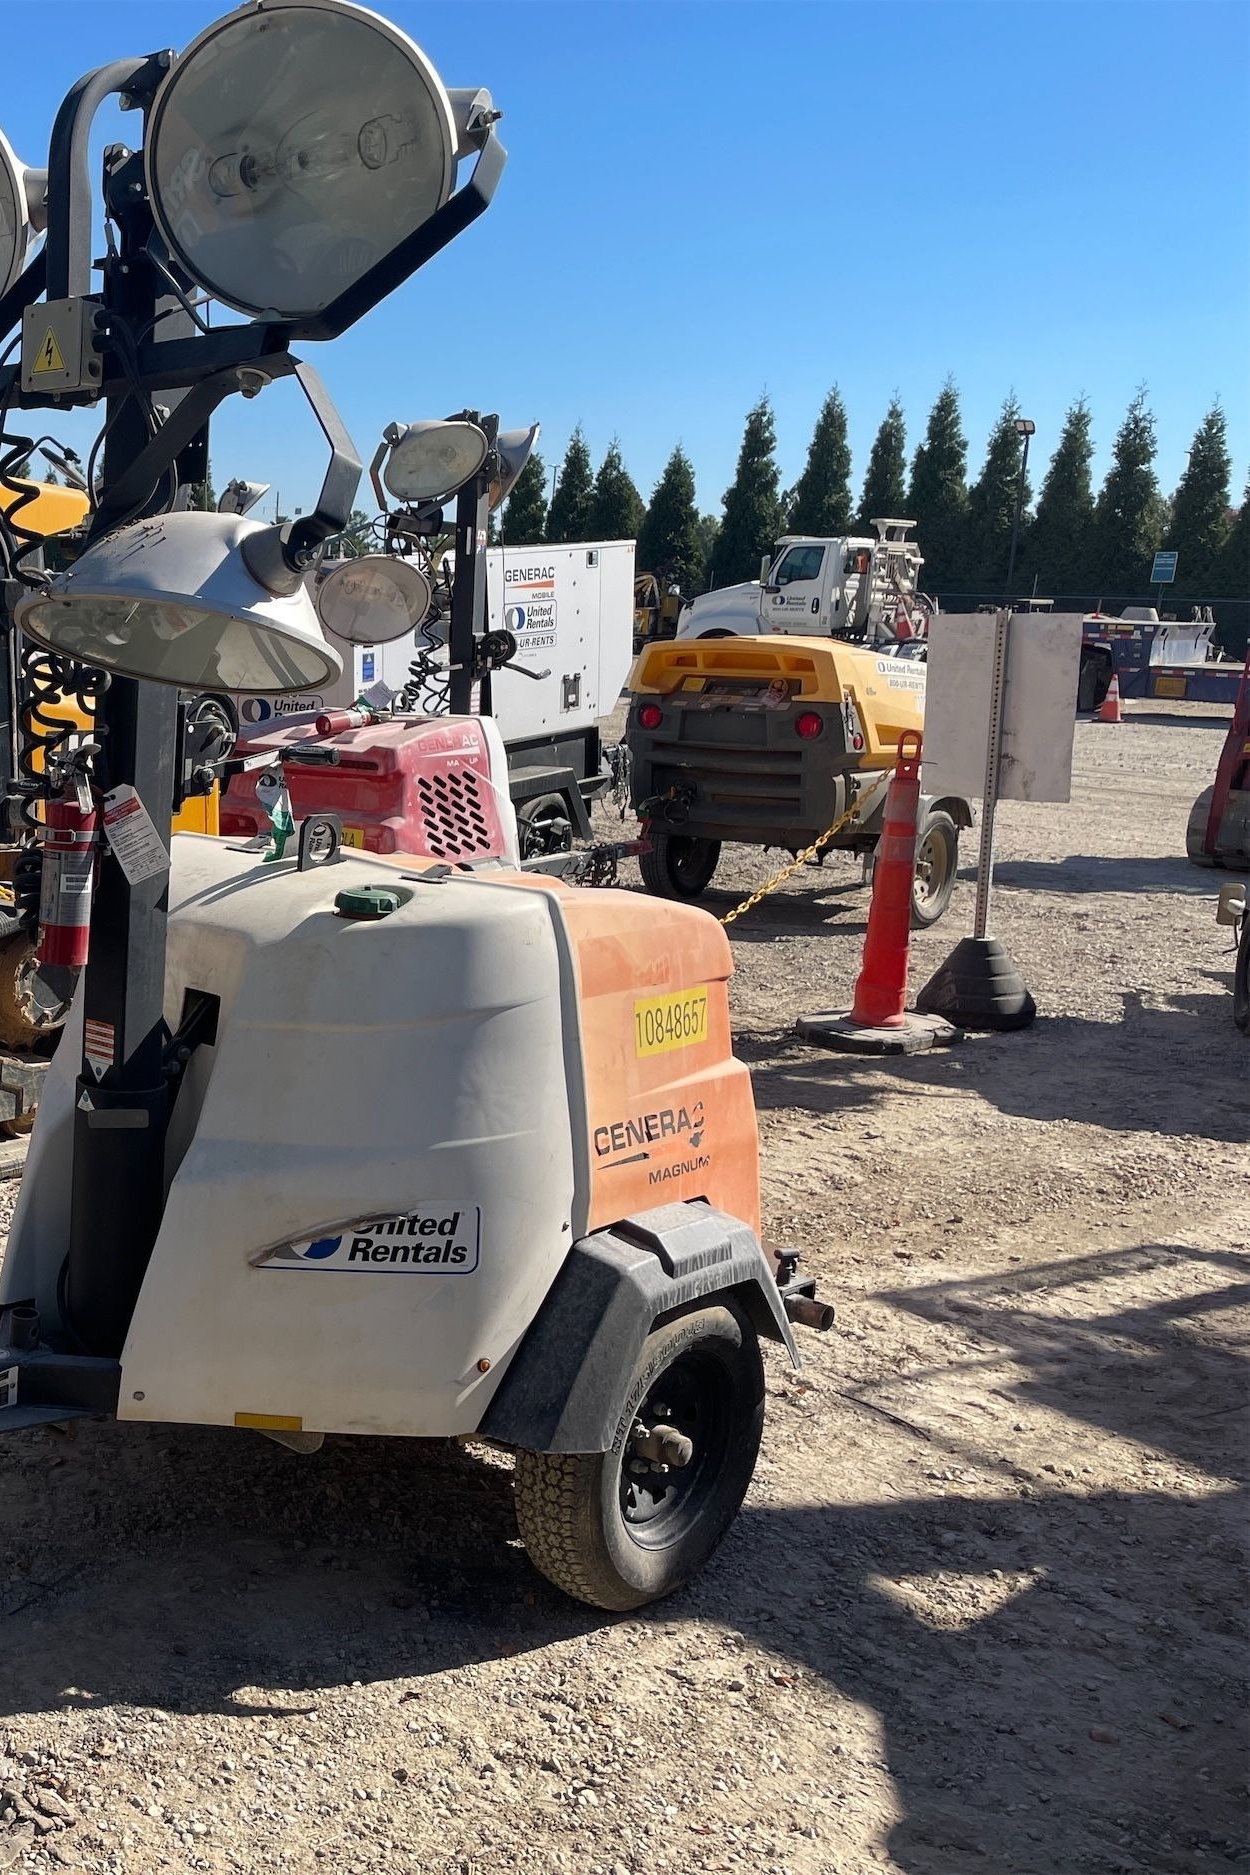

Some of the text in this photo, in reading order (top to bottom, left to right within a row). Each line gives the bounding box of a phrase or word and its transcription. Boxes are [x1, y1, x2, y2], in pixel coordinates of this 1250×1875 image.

[505, 566, 555, 582] GENERAC
[532, 591, 554, 599] MOBILE
[527, 605, 553, 618] United
[527, 618, 554, 630] Rentals
[518, 635, 554, 648] -UR-RENTS
[274, 701, 315, 713] United
[636, 997, 707, 1048] 10848657
[648, 1155, 710, 1184] MAGNUM
[348, 1238, 468, 1264] Rentals
